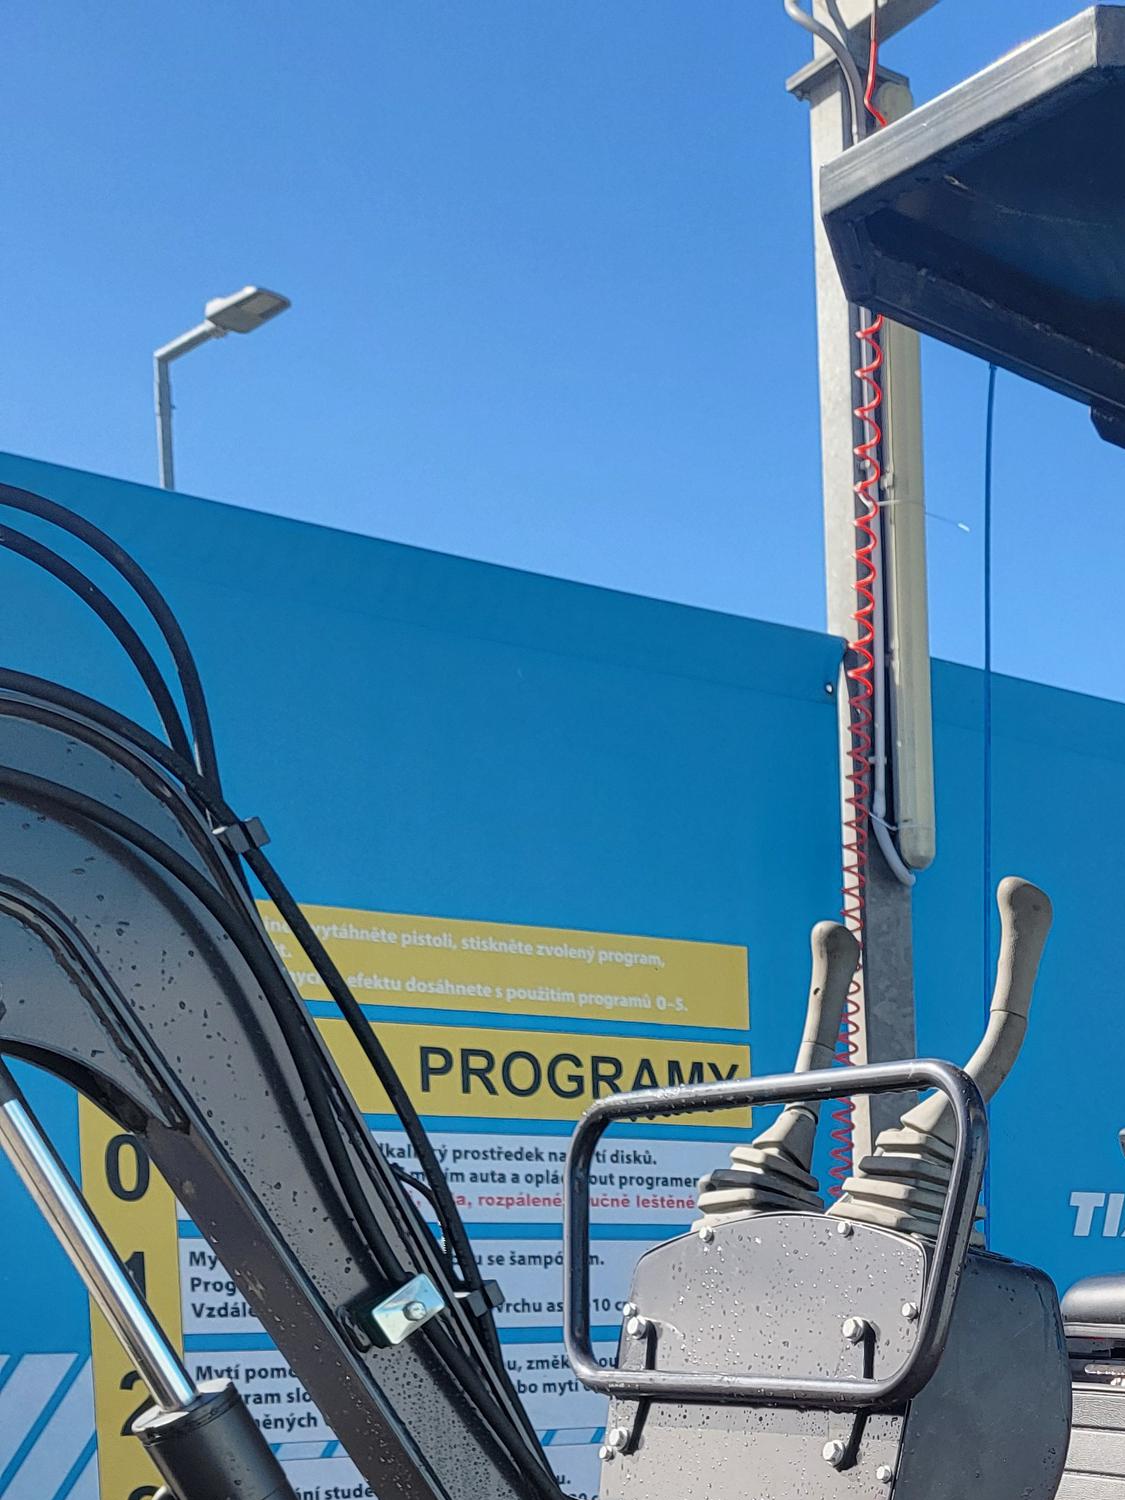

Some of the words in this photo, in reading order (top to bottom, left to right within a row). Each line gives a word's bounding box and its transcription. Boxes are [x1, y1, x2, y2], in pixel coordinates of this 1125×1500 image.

[401, 931, 457, 950] pistoli,
[461, 935, 533, 956] stiskněte
[537, 944, 595, 964] zvolený
[598, 948, 665, 968] program,
[347, 971, 401, 991] efektu
[405, 976, 491, 998] dosáhnete
[495, 988, 503, 999] s
[506, 985, 575, 1003] použitím
[579, 993, 651, 1010] programů
[452, 1146, 544, 1164] prostředek
[610, 1150, 657, 1165] disků.
[105, 1134, 149, 1202] 0
[469, 1170, 506, 1183] auta
[511, 1172, 520, 1183] a
[591, 1193, 630, 1207] učně
[636, 1194, 695, 1209] leštěné
[487, 1255, 505, 1266] se
[191, 1277, 236, 1296] Prog
[325, 1483, 373, 1500] stude
